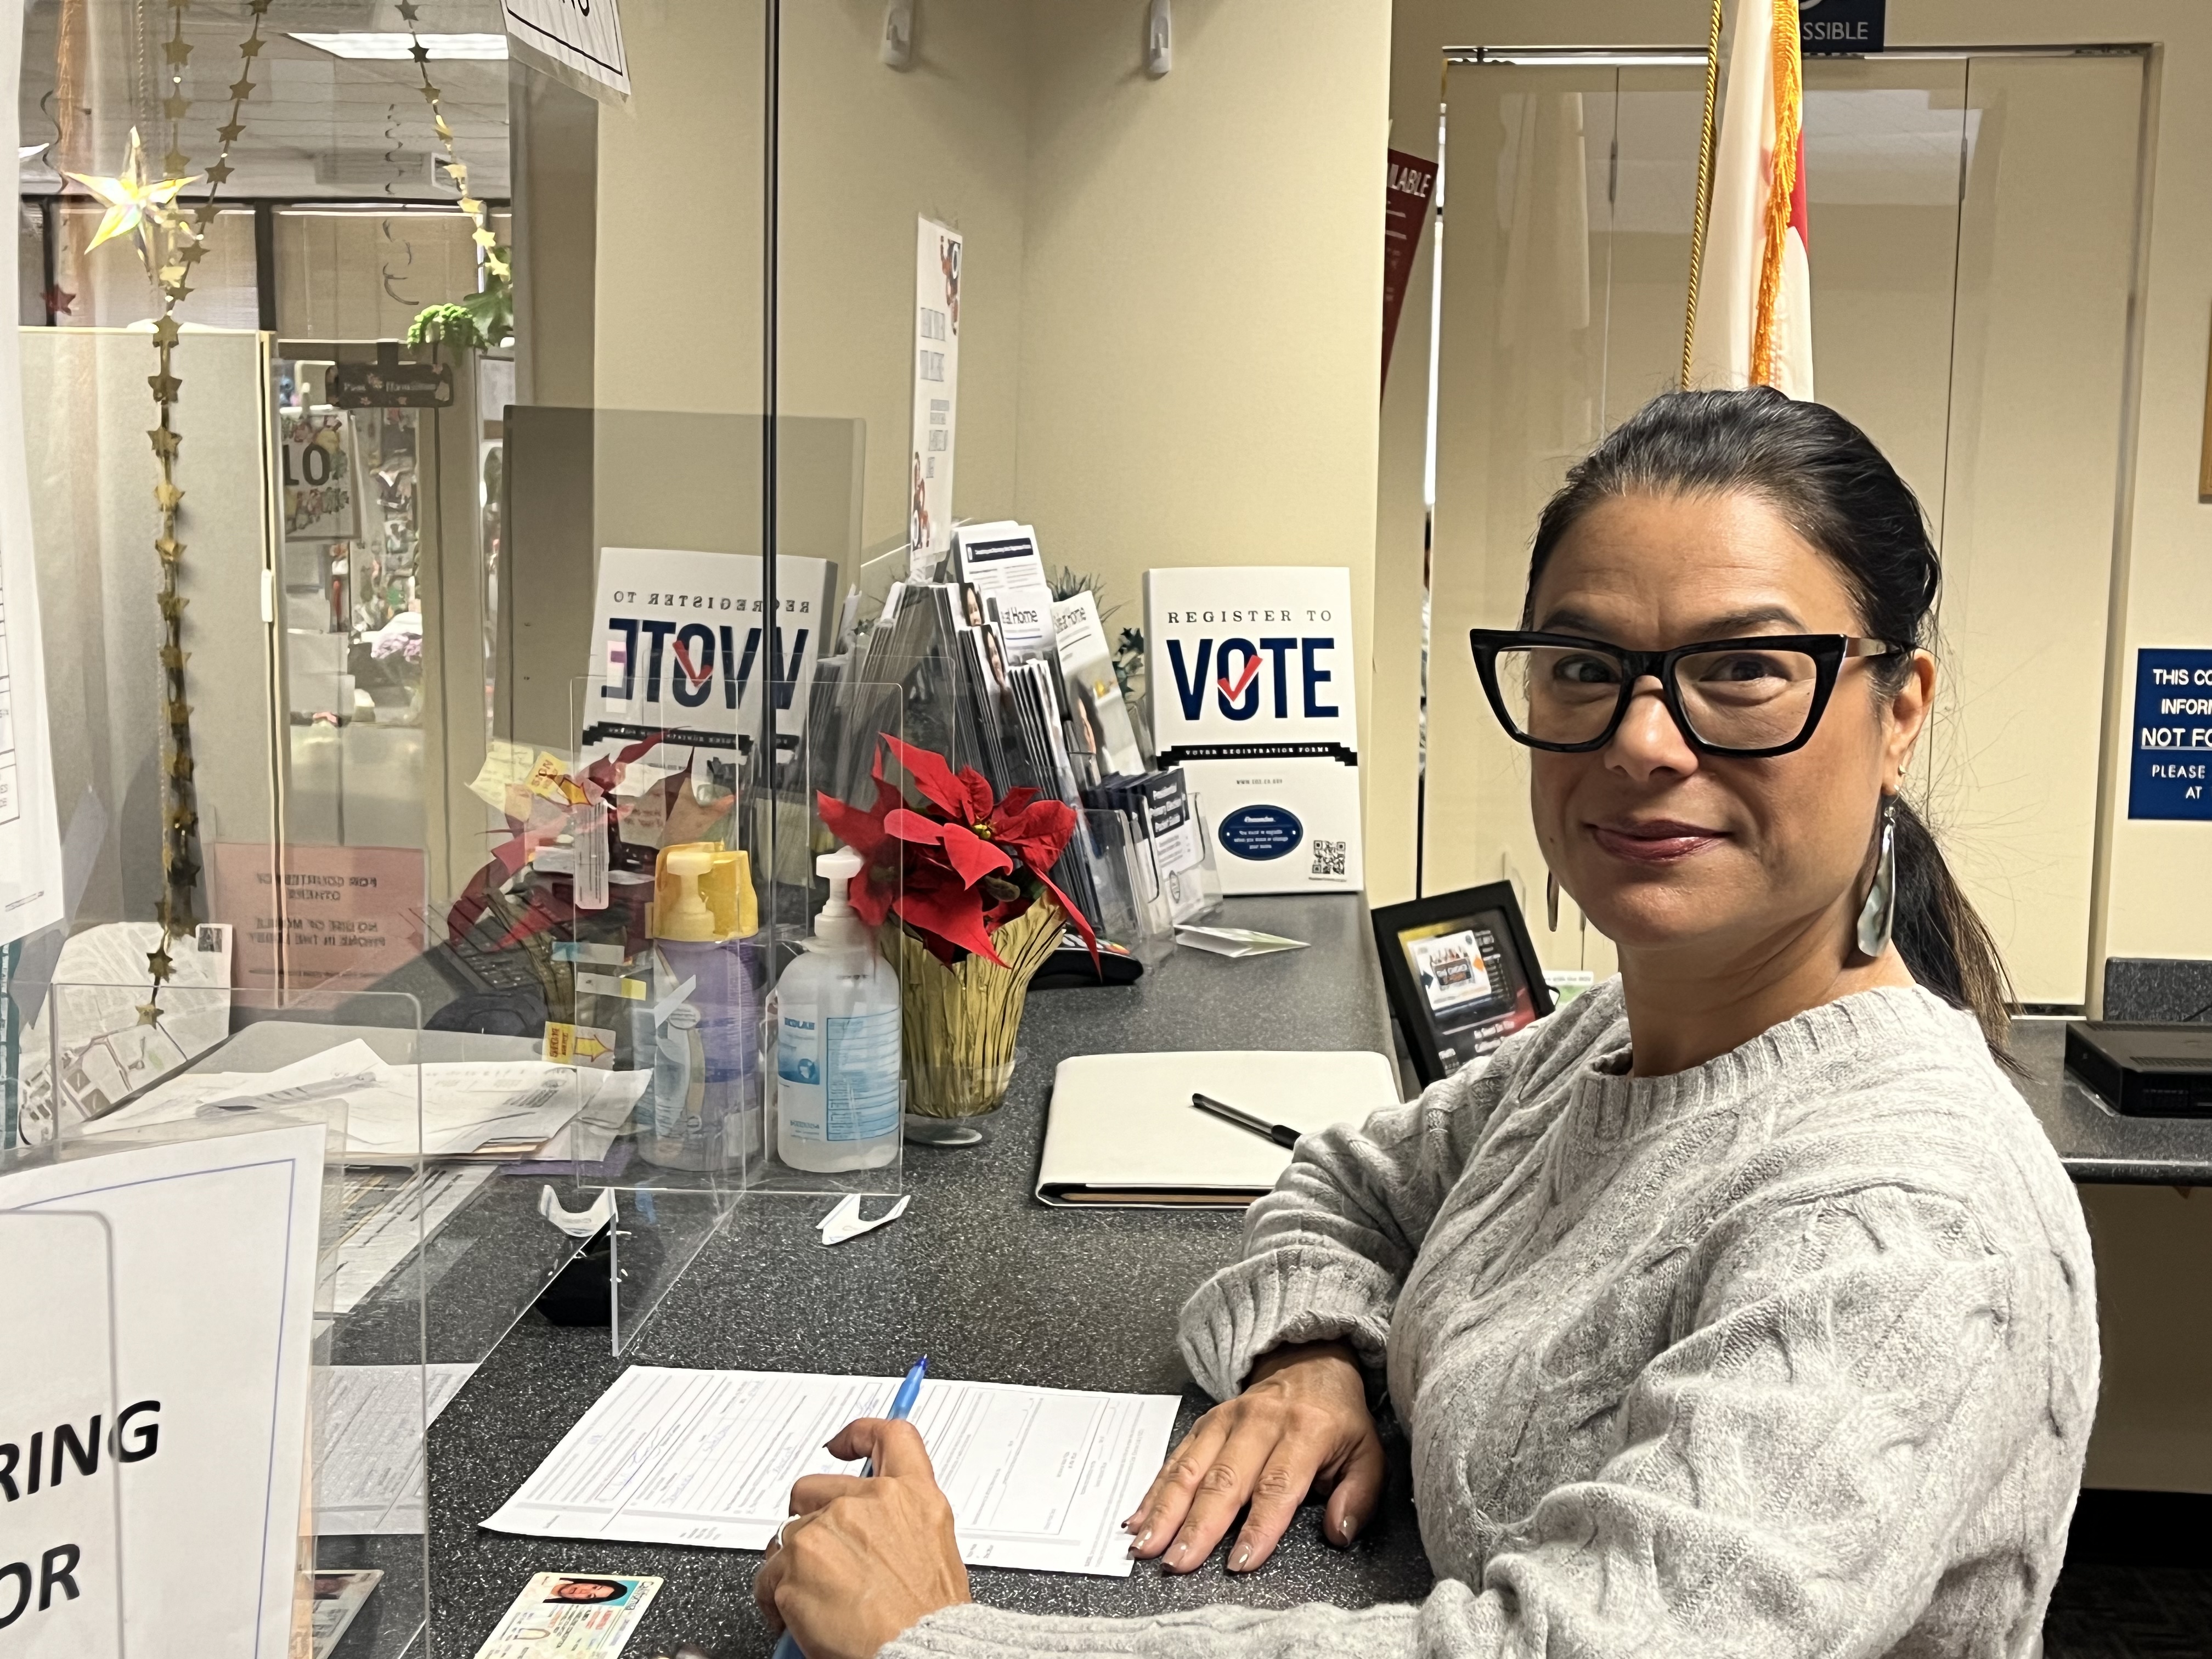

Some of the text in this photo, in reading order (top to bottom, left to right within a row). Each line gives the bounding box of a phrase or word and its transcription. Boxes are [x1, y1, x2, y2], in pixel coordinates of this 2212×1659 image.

[1167, 610, 1331, 623] REGISTER TO
[1166, 637, 1339, 721] VOTE
[2153, 669, 2189, 685] THIS
[2142, 727, 2186, 747] NOT
[2152, 764, 2205, 778] PLEASE
[2186, 786, 2202, 799] AT
